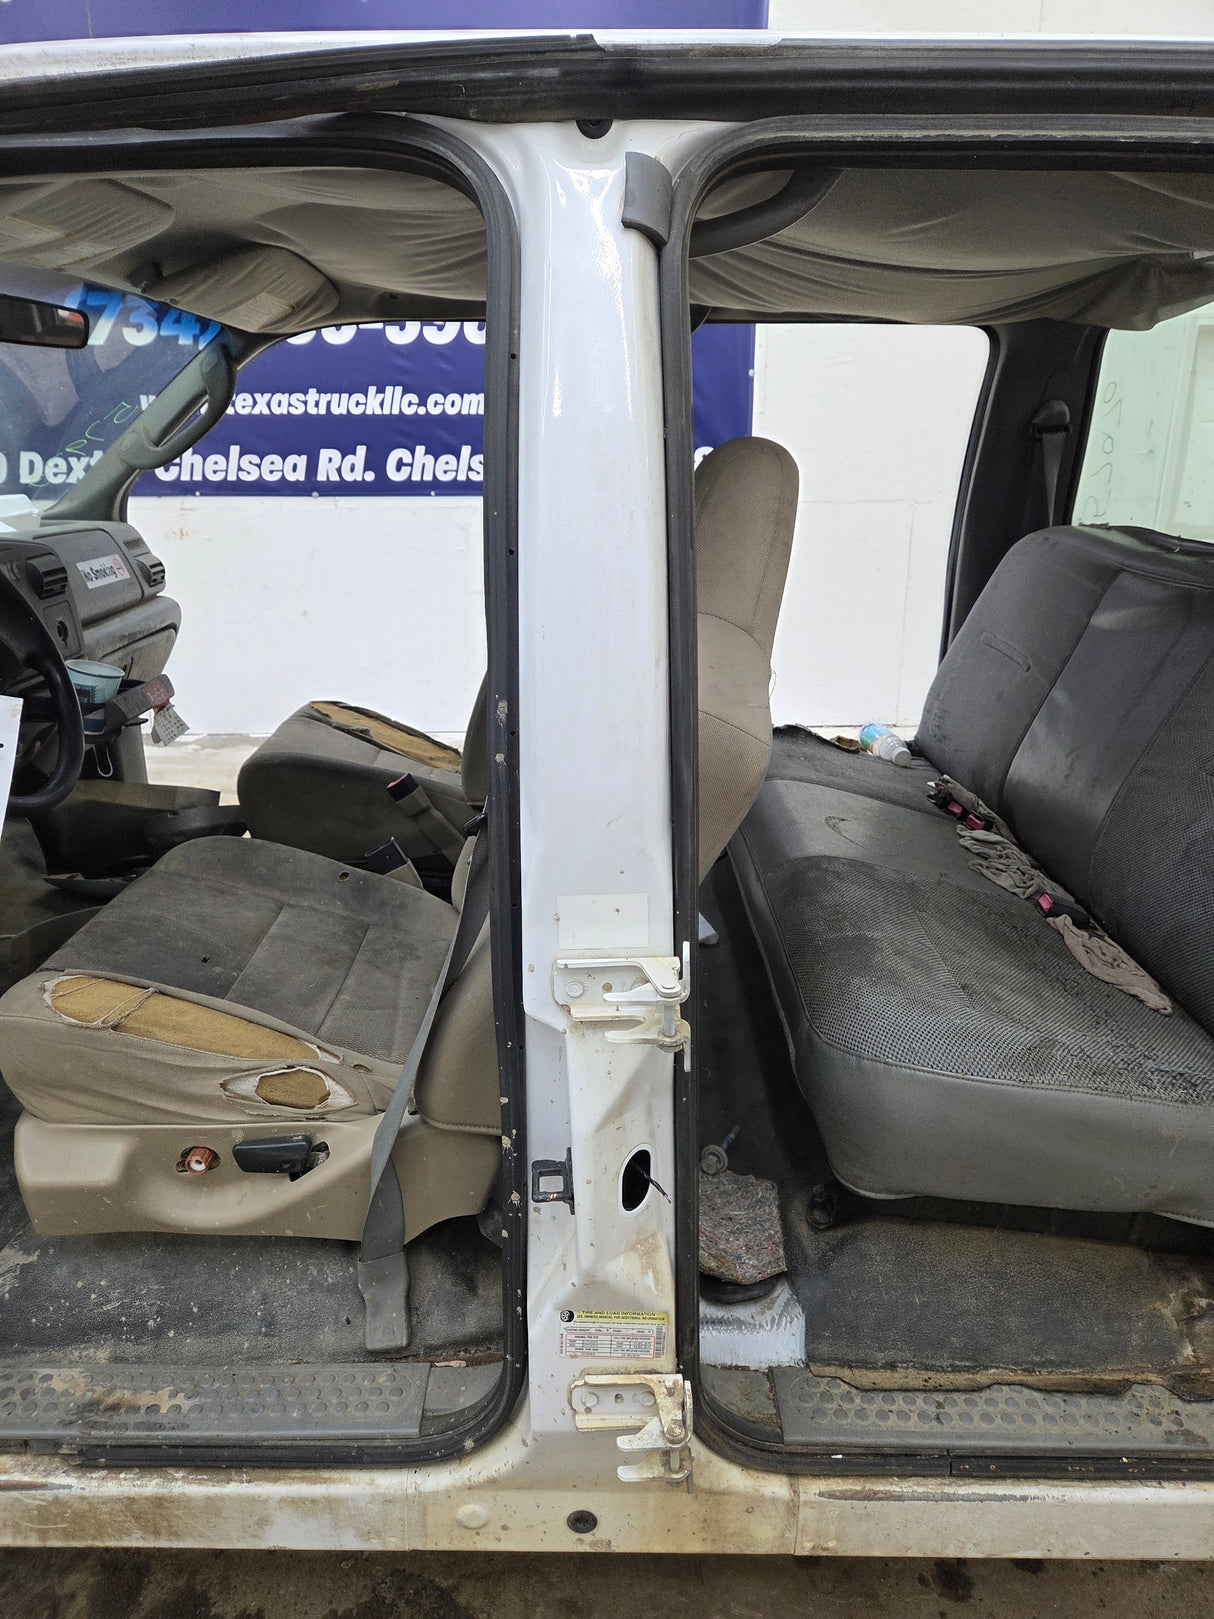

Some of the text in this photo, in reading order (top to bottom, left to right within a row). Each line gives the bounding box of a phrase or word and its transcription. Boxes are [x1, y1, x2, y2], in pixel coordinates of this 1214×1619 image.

[154, 445, 307, 482] Chelsea
[316, 445, 376, 482] Rd.
[80, 562, 118, 583] No Smoking
